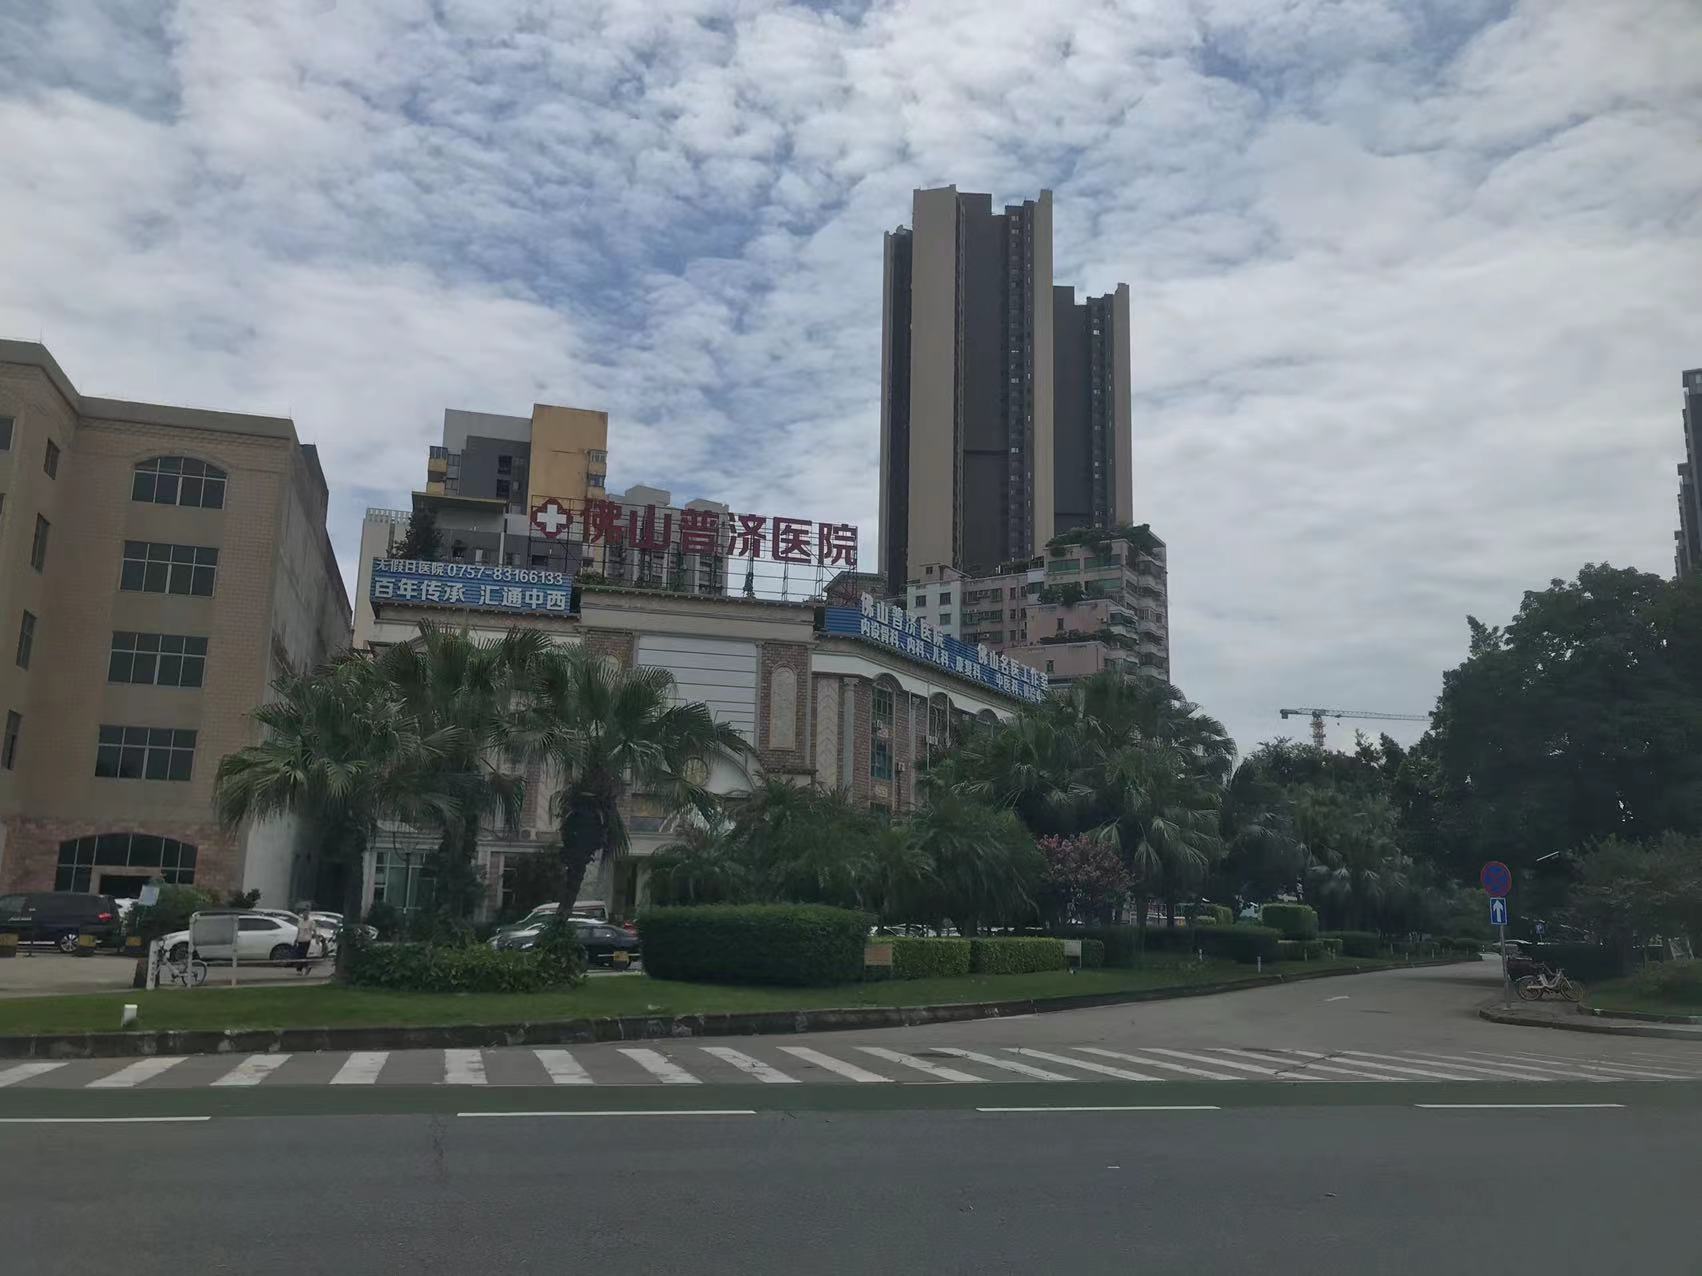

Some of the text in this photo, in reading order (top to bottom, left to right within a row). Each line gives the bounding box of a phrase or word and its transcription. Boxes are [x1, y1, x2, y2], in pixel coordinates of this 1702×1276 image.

[583, 498, 858, 567] 佛山普济医院
[374, 576, 567, 612] 百年传承 汇通中西
[376, 558, 563, 586] 无假日医院 0757-83166133
[861, 592, 945, 649] 佛山普济医院
[977, 643, 1049, 692] 佛山名医工作室
